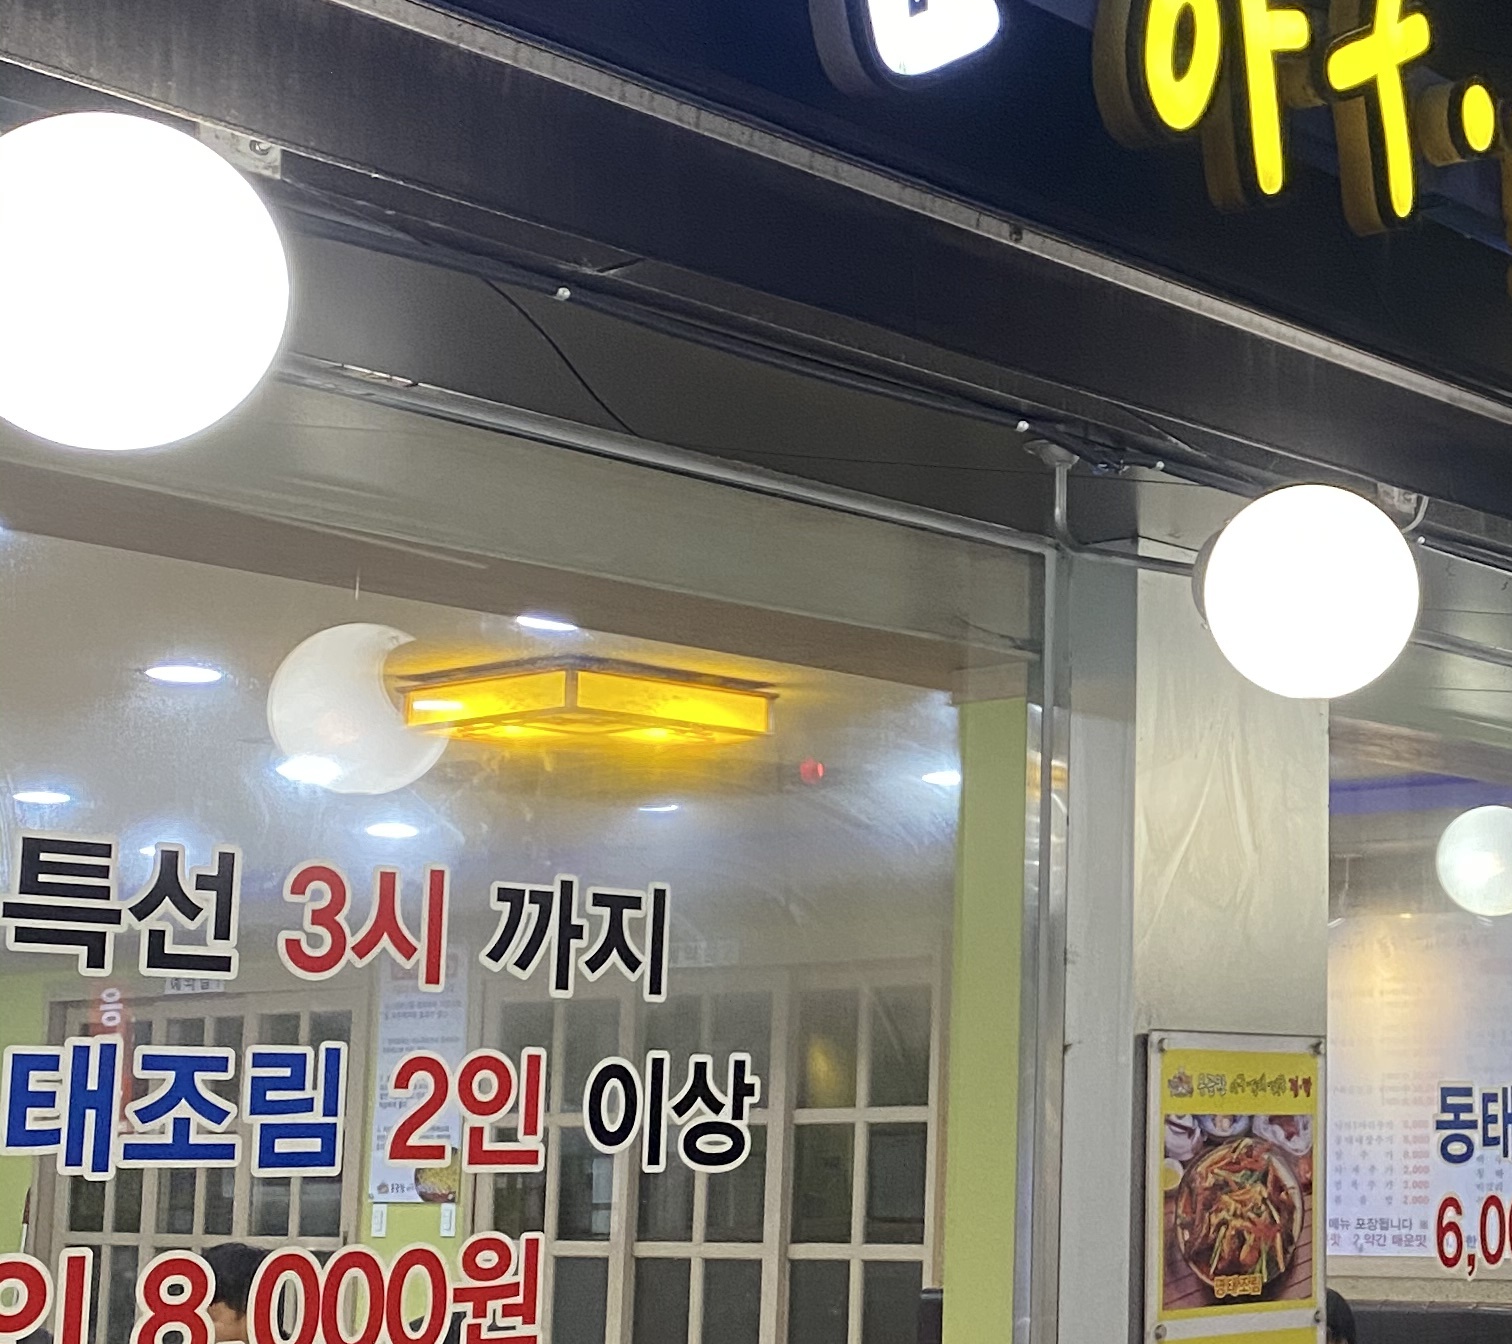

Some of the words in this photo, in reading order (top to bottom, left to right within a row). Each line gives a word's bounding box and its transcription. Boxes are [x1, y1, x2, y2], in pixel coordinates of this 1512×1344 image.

[2, 836, 237, 975] 특선
[283, 864, 449, 988] 3시
[485, 878, 668, 998] 까지
[4, 1041, 345, 1175] 태조림
[388, 1047, 543, 1169] 2인
[585, 1054, 757, 1170] 이상
